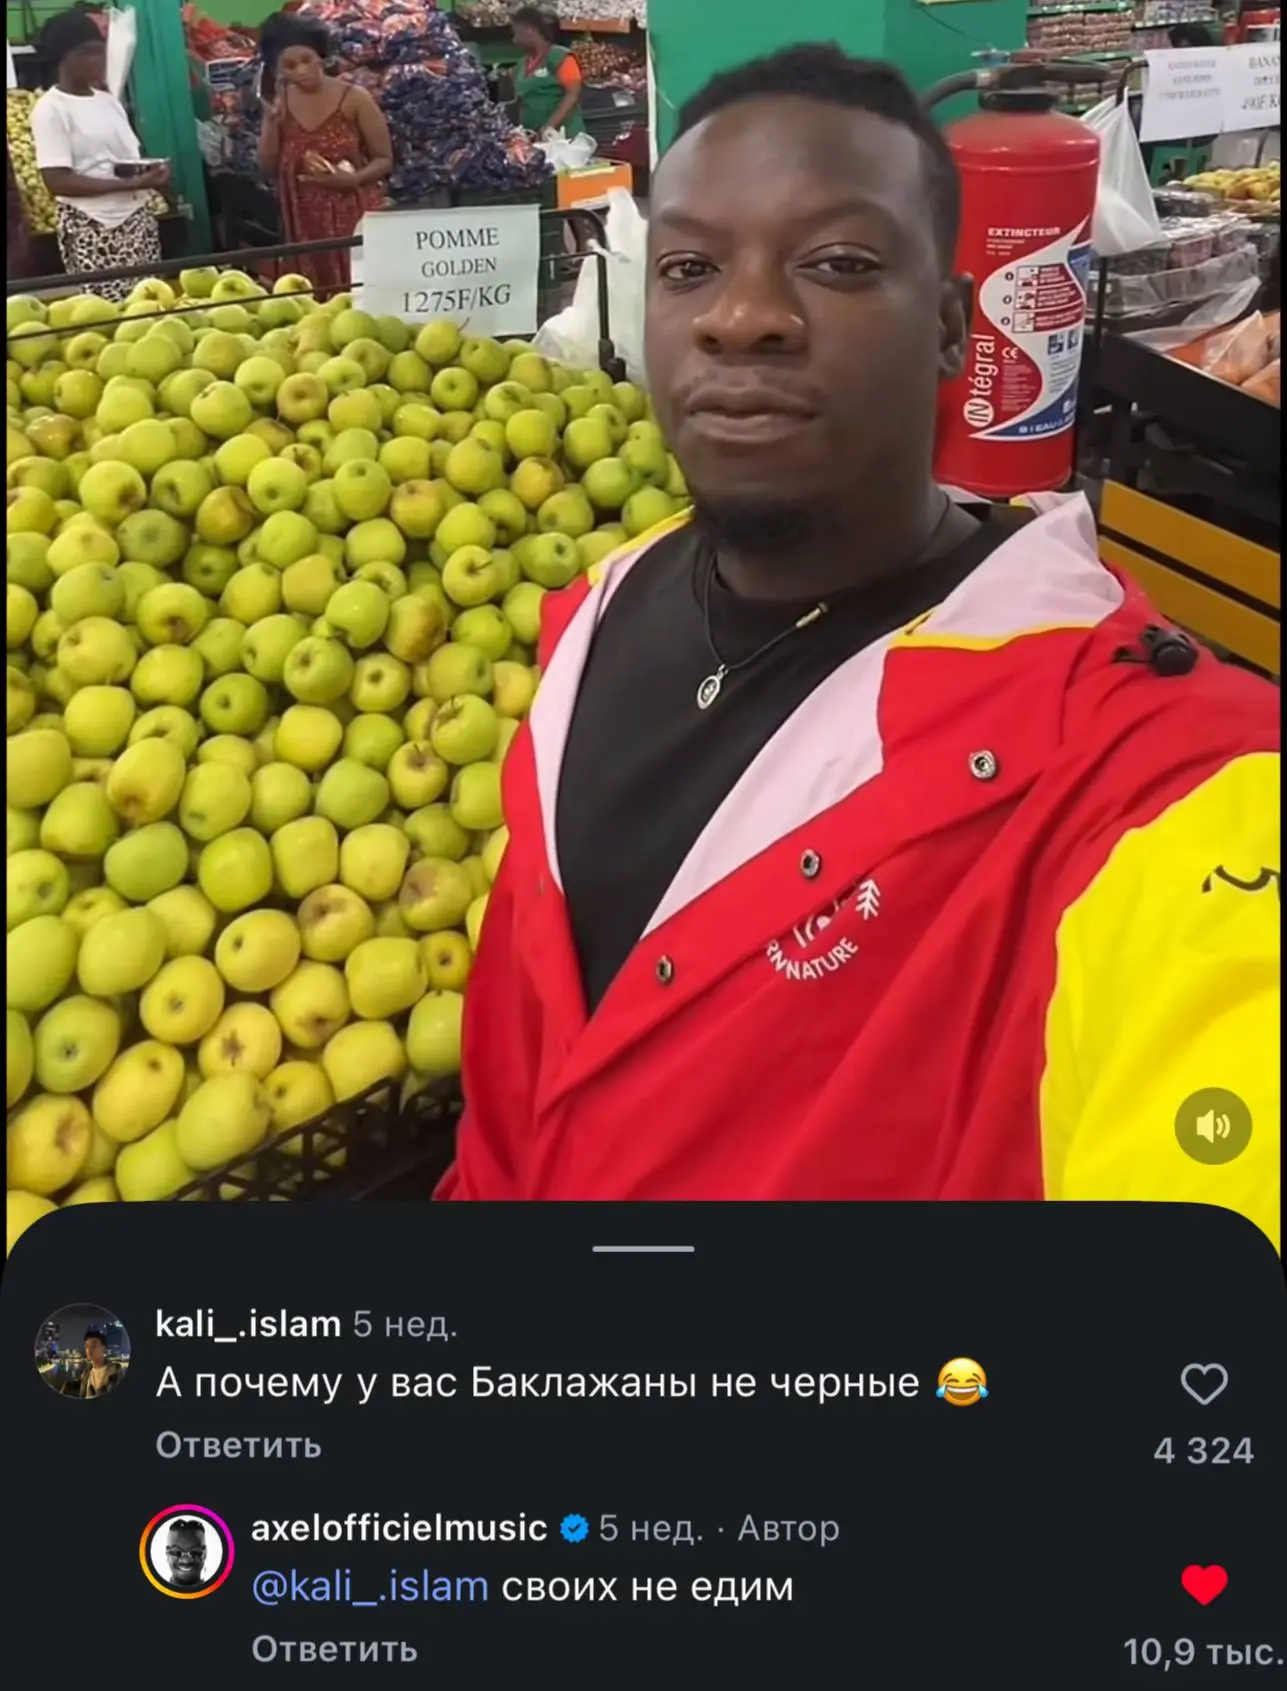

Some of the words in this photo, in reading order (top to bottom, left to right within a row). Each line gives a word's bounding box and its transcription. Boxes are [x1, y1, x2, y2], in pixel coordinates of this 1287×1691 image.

[416, 228, 500, 250] POMME
[421, 257, 497, 278] GOLDEN
[402, 284, 512, 313] 1275F/KG
[785, 937, 859, 980] NATURE
